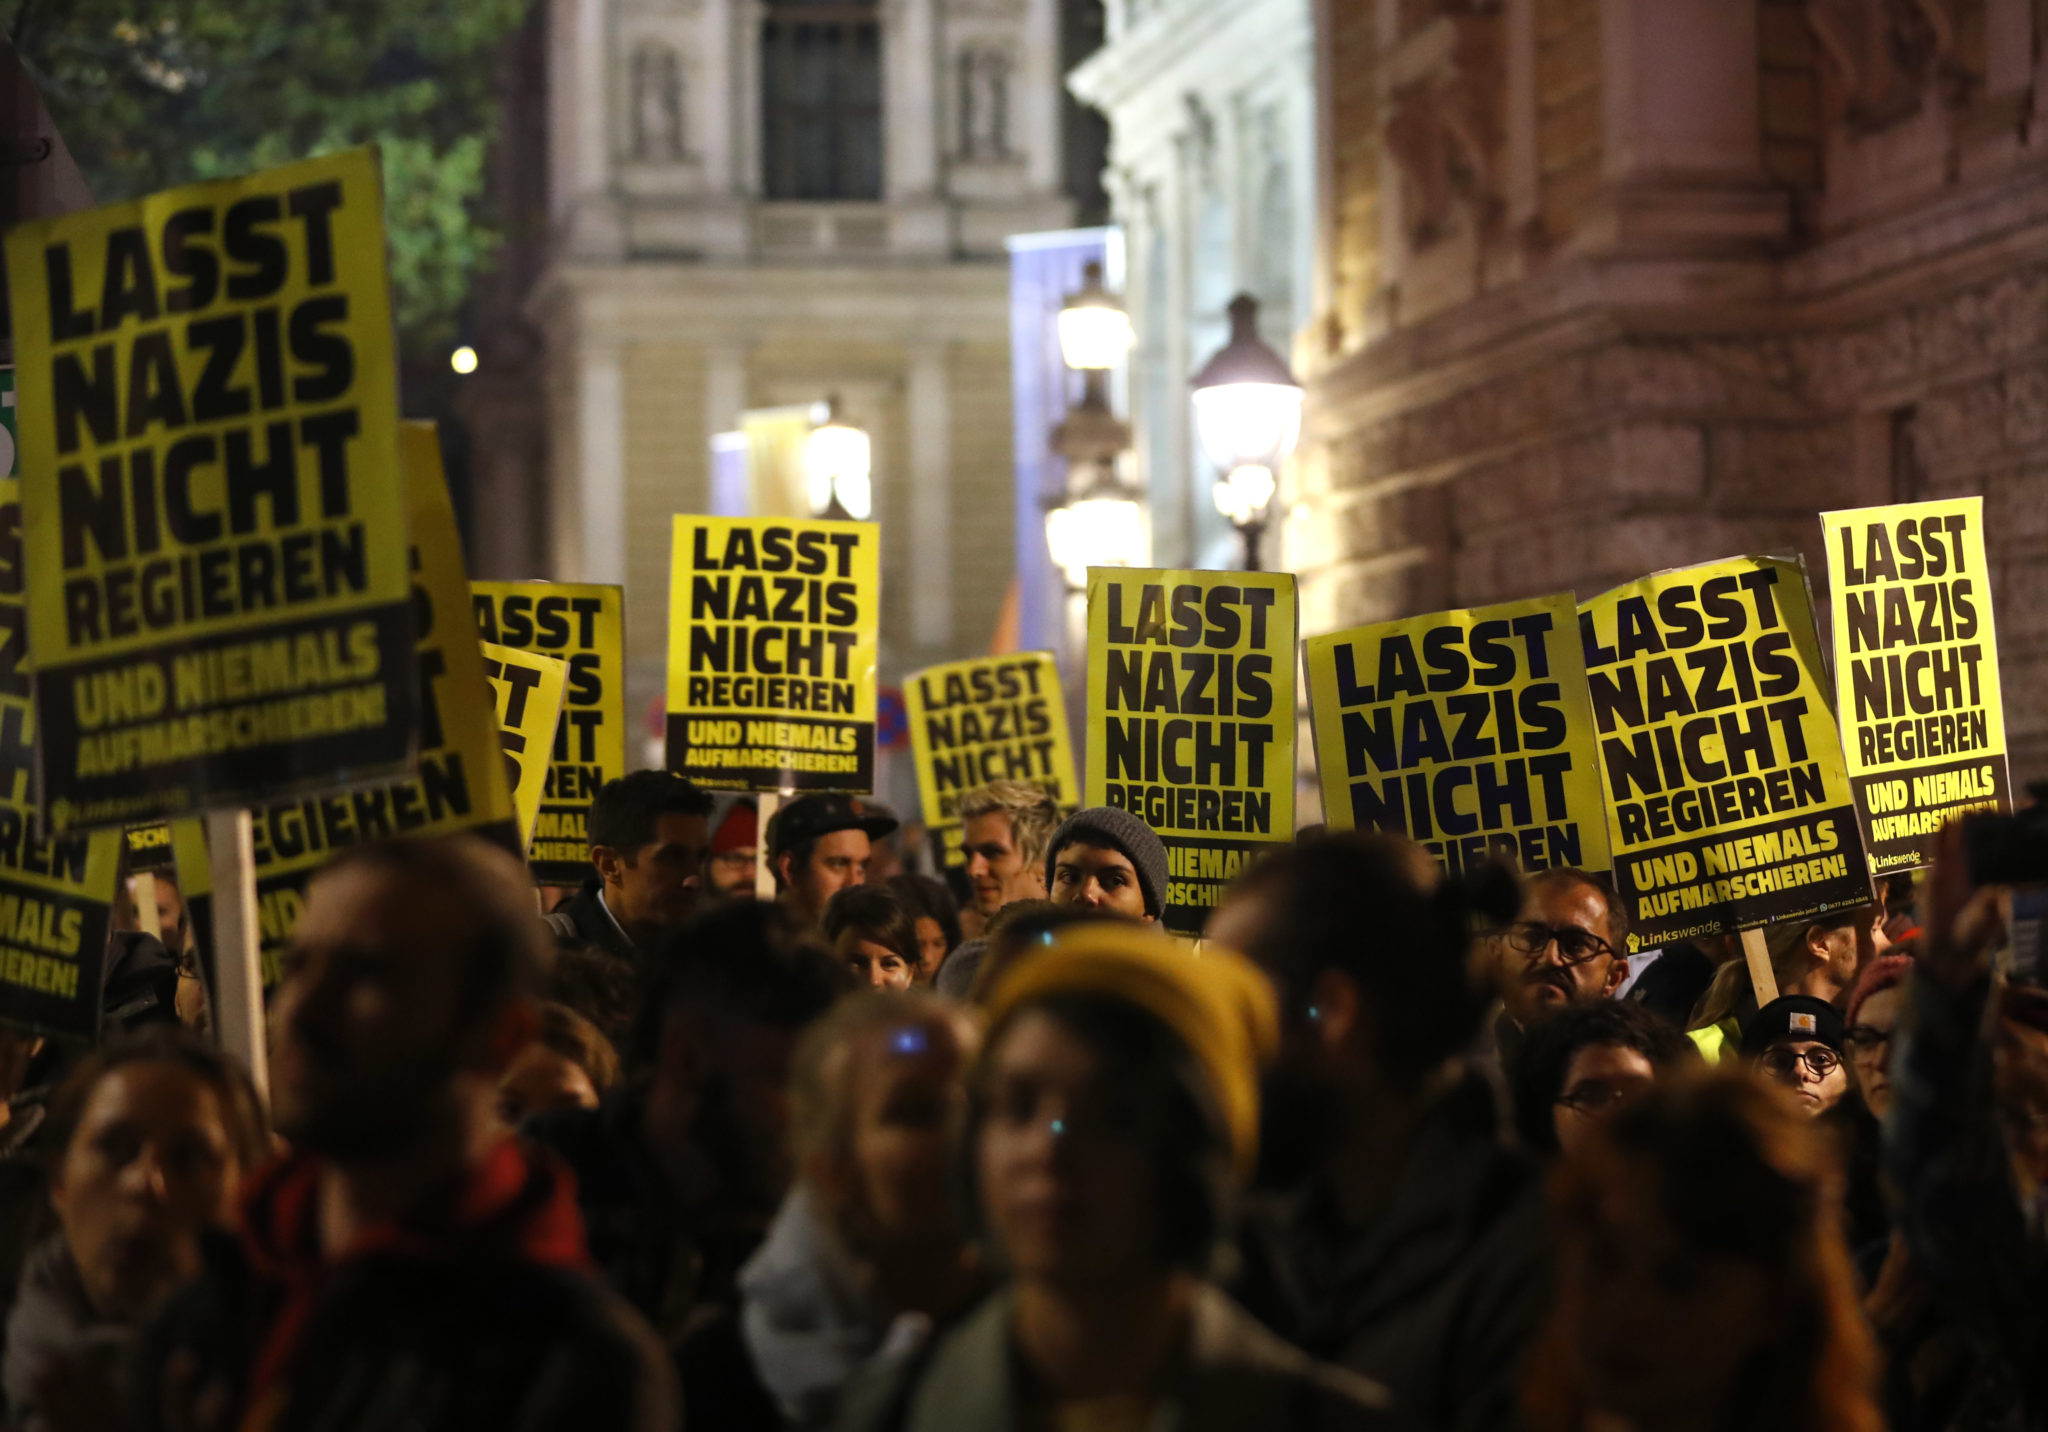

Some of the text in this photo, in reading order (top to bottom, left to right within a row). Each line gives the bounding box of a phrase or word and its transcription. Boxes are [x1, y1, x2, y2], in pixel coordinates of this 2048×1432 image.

[46, 180, 343, 343] LASST
[53, 295, 355, 456] NAZIS
[59, 408, 360, 570] NICHT
[692, 527, 859, 577] LASST
[1840, 514, 1966, 586] LASST
[65, 523, 367, 647] REGIEREN
[691, 576, 859, 626] NAZIS
[1107, 583, 1275, 650] LASST
[1577, 567, 1779, 667] LASST
[1846, 579, 1978, 653] NAZIS
[473, 594, 601, 649] ASST
[690, 626, 858, 680] NICHT
[75, 622, 381, 730] UND NIEMALS
[918, 660, 1041, 711] LASST
[1106, 650, 1273, 718] NAZIS
[1333, 612, 1553, 708] LASST
[1586, 632, 1800, 734] NAZIS
[1851, 644, 1982, 722] NICHT
[688, 677, 856, 714] REGIEREN
[926, 698, 1050, 751] NAZIS
[684, 747, 858, 773] AUFMARSCHIEREN!
[687, 720, 857, 753] UND NIEMALS
[1106, 716, 1273, 787] NICHT
[1341, 683, 1567, 777] NAZIS
[1601, 696, 1808, 802] NICHT
[1858, 709, 1988, 767] REGIEREN
[933, 740, 1054, 792] NICHT
[1350, 751, 1573, 841] NICHT
[1866, 765, 1995, 815] UND NIEMALS
[1106, 783, 1271, 834] REGIEREN
[1616, 762, 1826, 846] REGIEREN
[1631, 819, 1839, 892] UND NIEMALS
[1638, 853, 1848, 920] AUFMARSCHIEREN!
[1876, 850, 1921, 868] Linkswende
[1641, 920, 1721, 947] Linkswende
